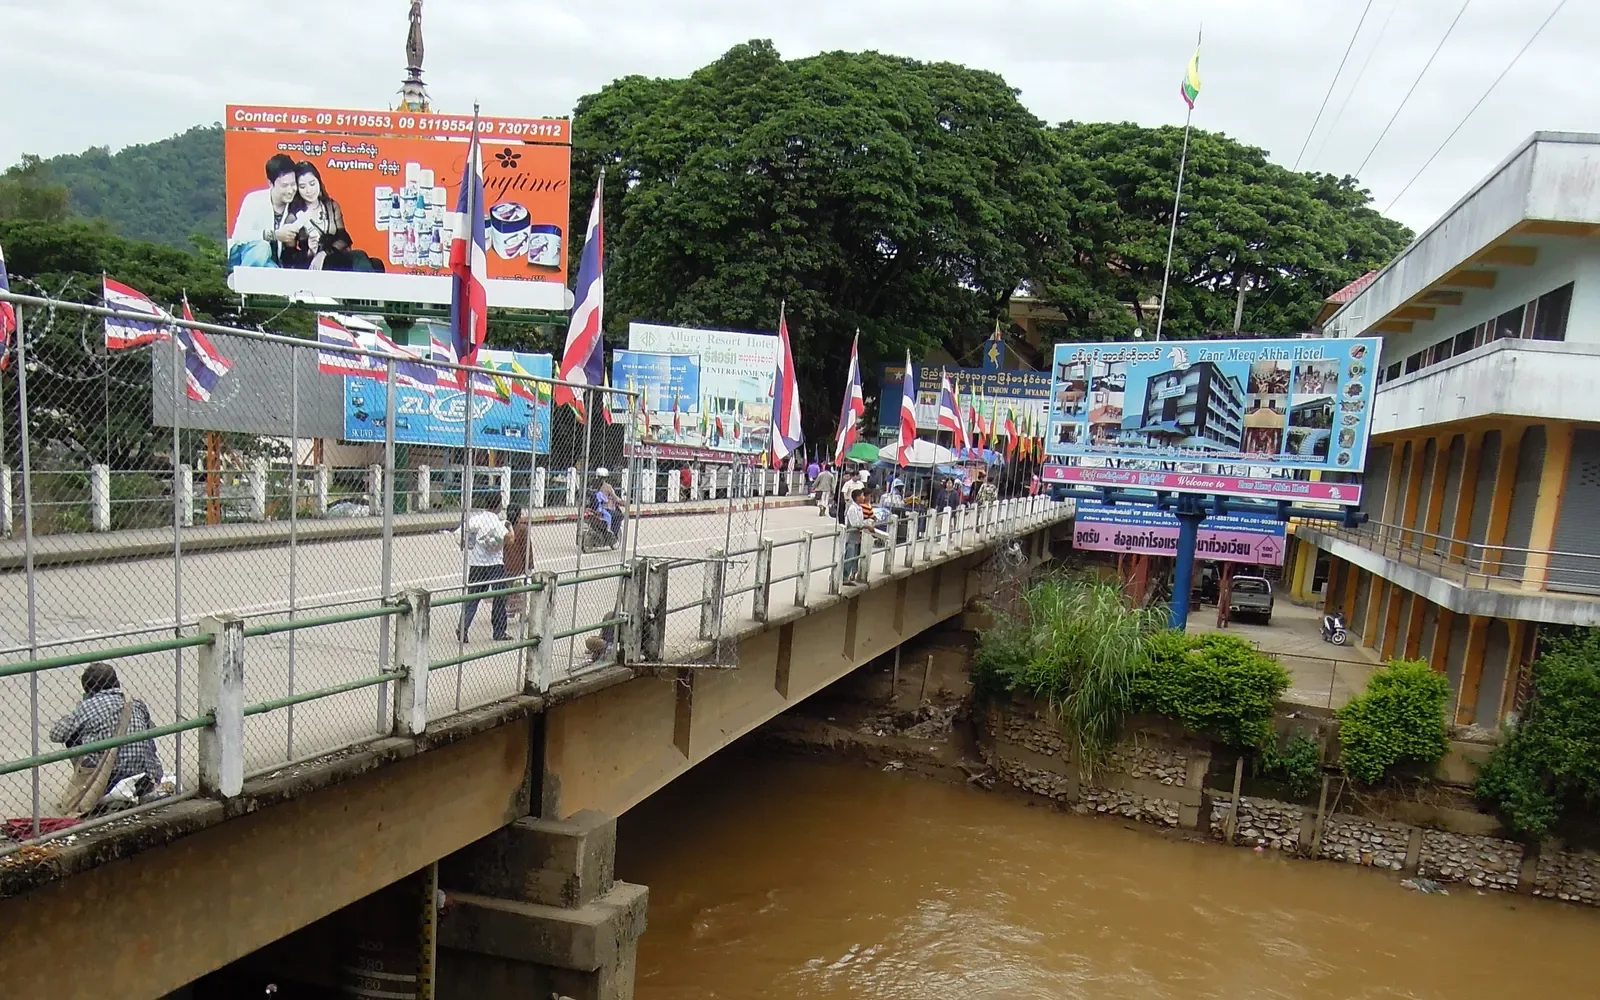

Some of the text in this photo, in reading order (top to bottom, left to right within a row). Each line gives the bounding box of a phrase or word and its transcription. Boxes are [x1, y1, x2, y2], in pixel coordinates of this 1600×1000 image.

[234, 110, 287, 124] Contact
[291, 113, 313, 125] us-
[316, 113, 333, 125] 09
[336, 114, 395, 129] 5119553,
[398, 117, 415, 129] 09
[477, 121, 494, 133] 09
[498, 123, 562, 137] 73073112
[327, 158, 375, 171] Anytime
[668, 331, 774, 349] Allure Resort Hotel
[1199, 346, 1324, 363] Zanr Meeq Akha Hotel
[1012, 387, 1021, 395] OF
[1025, 388, 1050, 397] MYANM
[1177, 475, 1214, 488] Welcome
[1216, 478, 1225, 488] to
[358, 956, 385, 971] 380
[358, 976, 381, 990] 360
